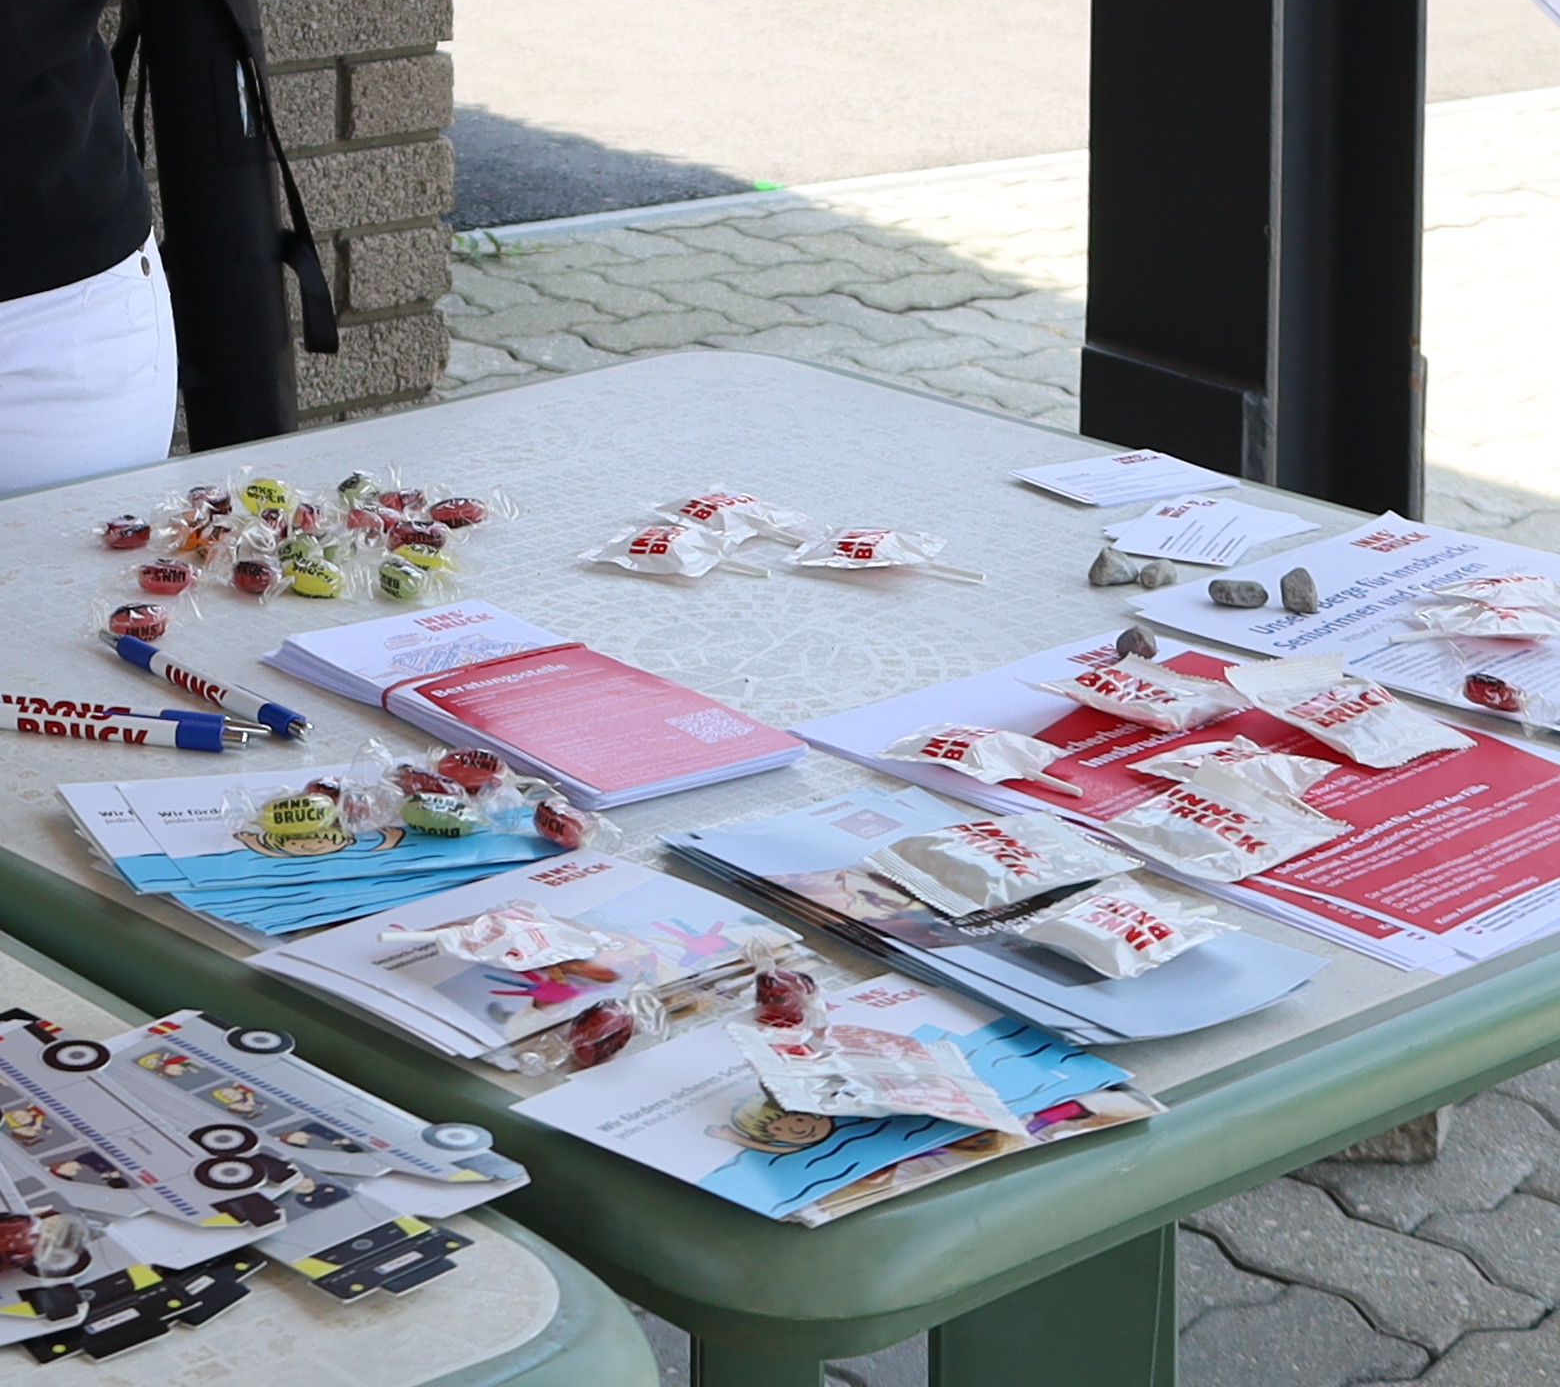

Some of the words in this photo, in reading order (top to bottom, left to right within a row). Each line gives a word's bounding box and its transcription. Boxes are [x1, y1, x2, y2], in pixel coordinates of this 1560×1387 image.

[1349, 529, 1397, 550] INNS'
[1370, 531, 1431, 553] BRUCK
[1317, 587, 1369, 610] Berge
[1366, 575, 1391, 593] für
[1389, 542, 1479, 579] Innsbrucks
[1273, 603, 1383, 650] Seniorinnen
[1380, 591, 1408, 606] und
[1411, 561, 1489, 594] Senioren
[412, 609, 463, 628] INNS'
[427, 613, 494, 633] BRUCK
[165, 663, 229, 708] INNS'
[430, 662, 570, 699] Beratungsstelle
[1077, 726, 1192, 769] Innsbrucker
[98, 809, 126, 819] Wir
[157, 809, 185, 819] Wir
[272, 807, 326, 825] BRUCK
[531, 862, 579, 882] INNS'
[544, 863, 613, 887] BRUCK
[597, 1116, 624, 1132] Wir
[622, 1099, 671, 1123] fördern
